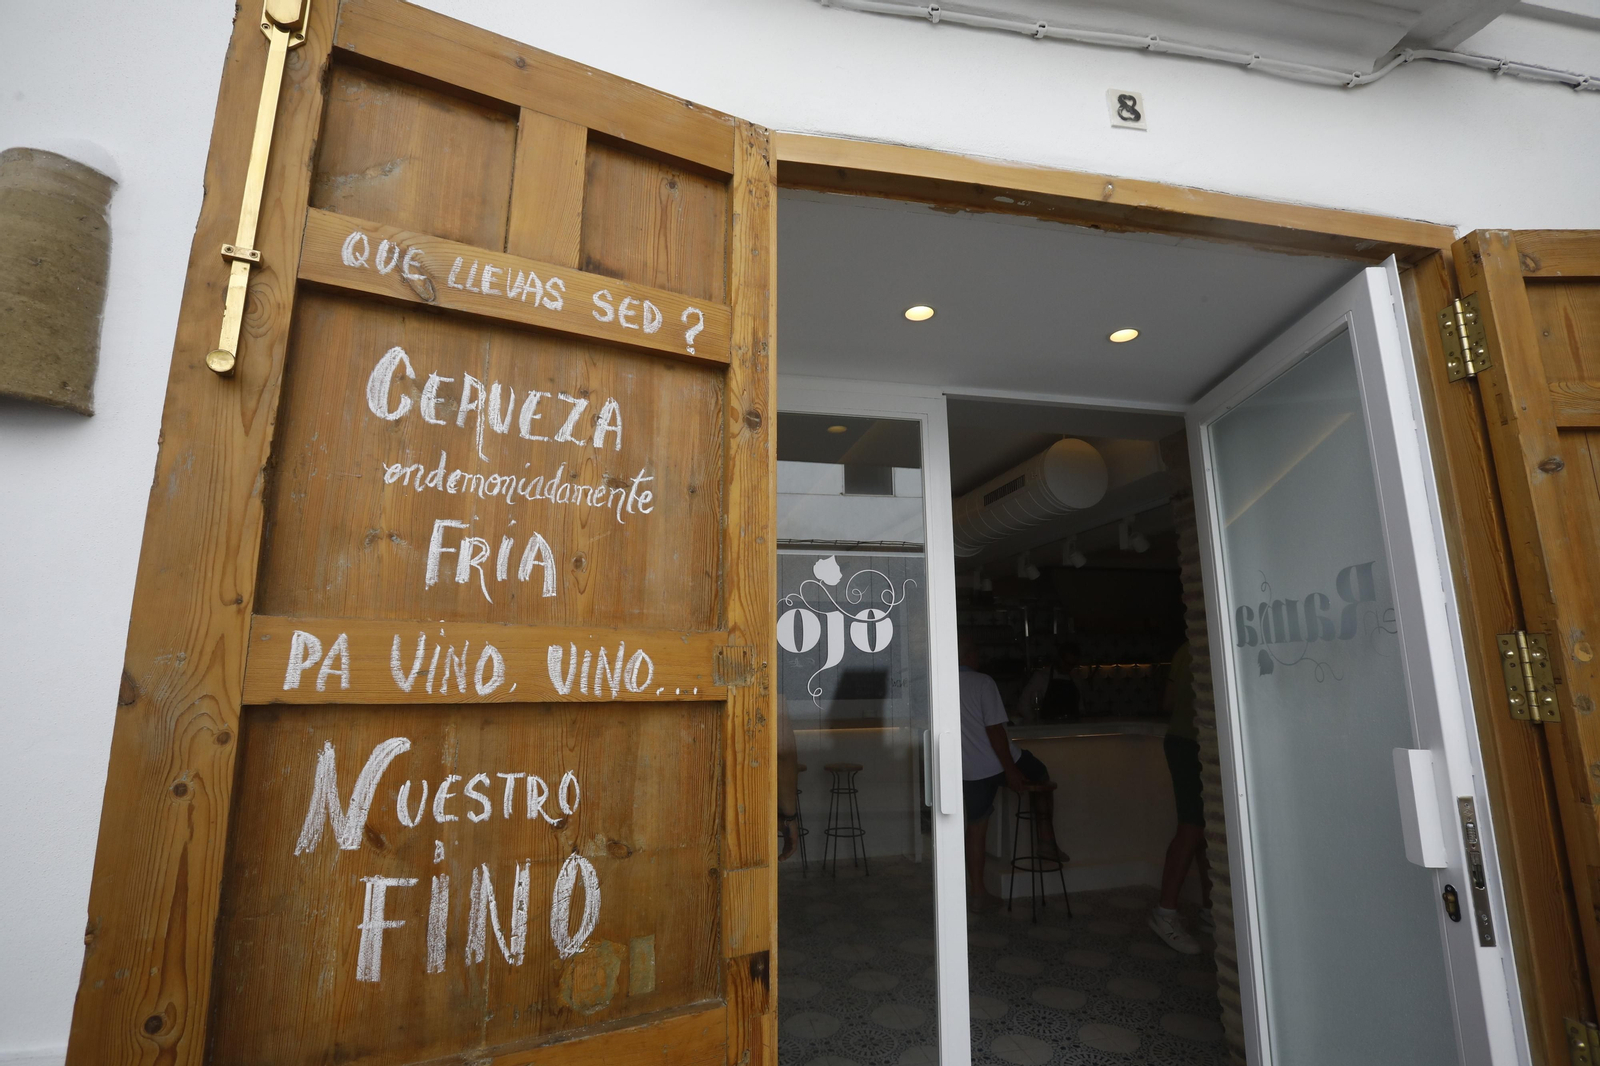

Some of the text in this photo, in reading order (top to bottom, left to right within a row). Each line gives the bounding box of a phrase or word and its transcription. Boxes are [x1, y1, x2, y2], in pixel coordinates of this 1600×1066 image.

[1117, 93, 1142, 122] 8
[341, 231, 705, 355] QUE LLEVAS SED ?
[366, 346, 623, 461] CERVEZA
[283, 630, 351, 692] PA
[294, 736, 581, 857] NUESTRO
[355, 839, 602, 983] FINO
